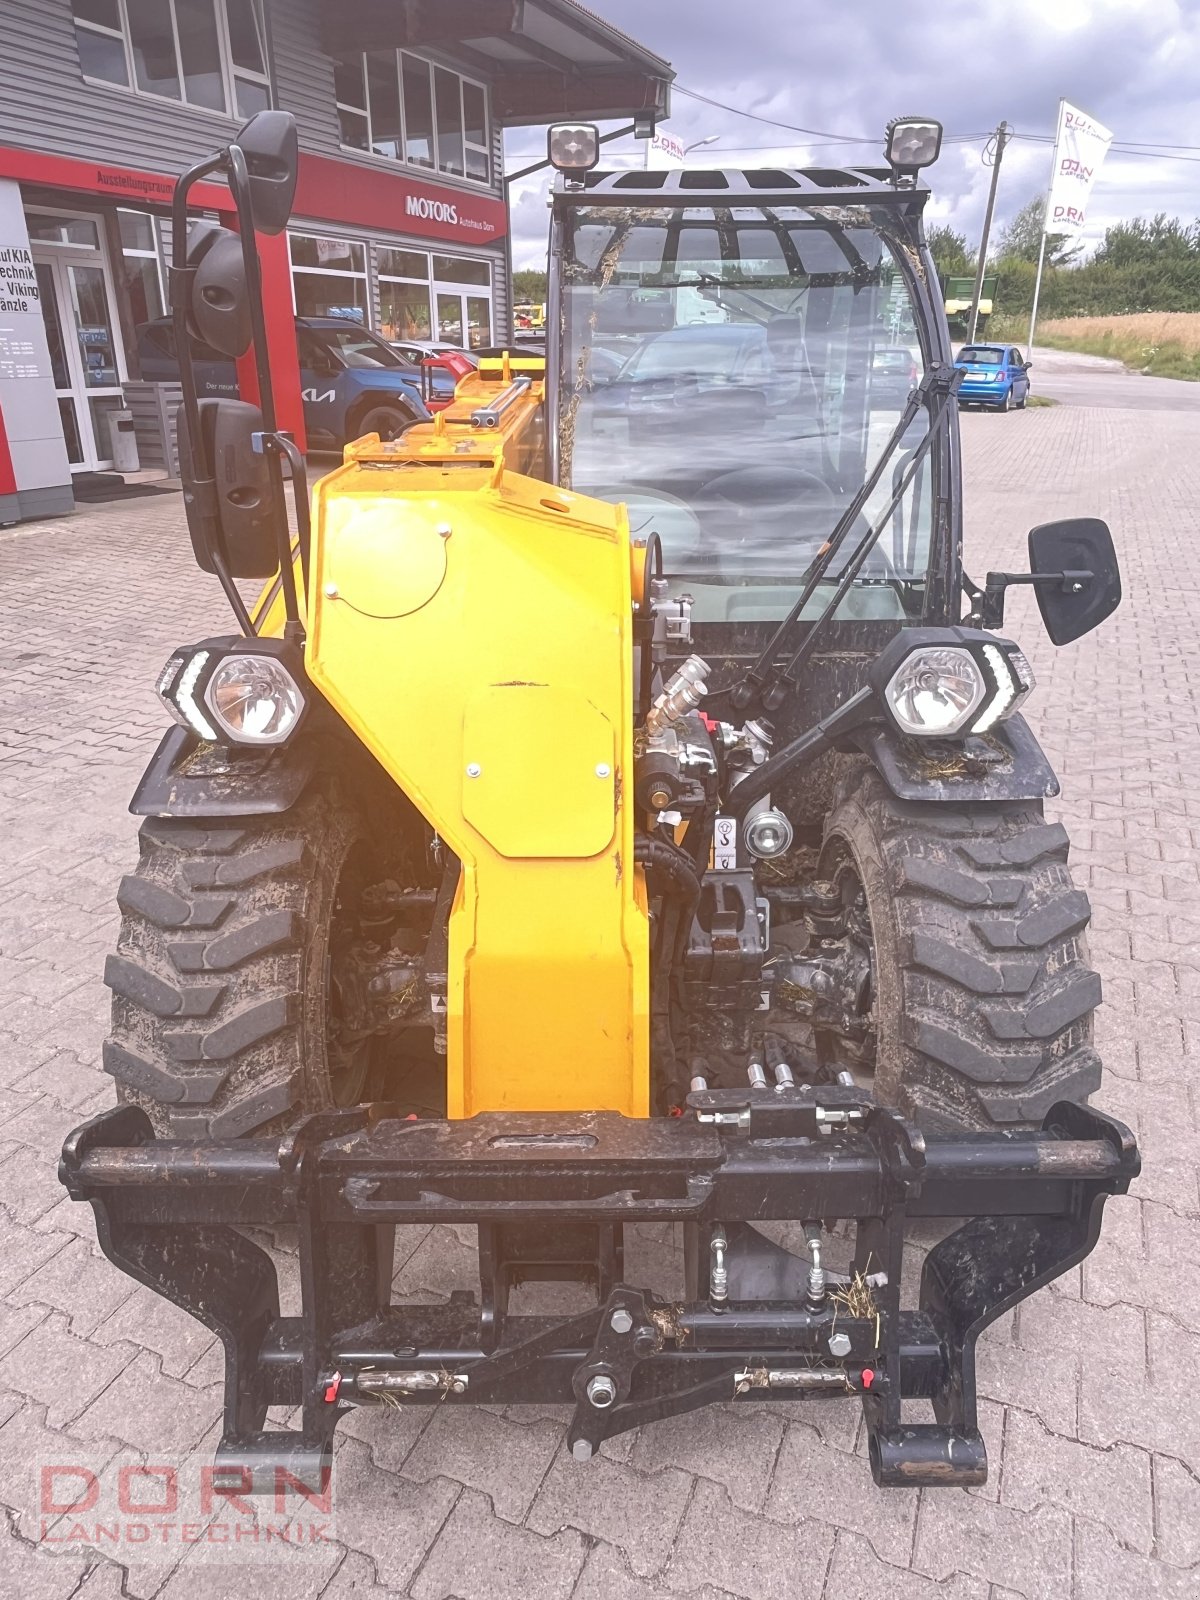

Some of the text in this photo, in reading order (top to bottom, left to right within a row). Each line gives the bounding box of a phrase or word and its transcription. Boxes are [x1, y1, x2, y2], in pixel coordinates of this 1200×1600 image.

[652, 133, 684, 157] DORN
[97, 170, 173, 194] Ausstellungsraum
[405, 195, 495, 232] MOTORS Autohaus Dorn
[0, 249, 31, 264] uf KIA
[0, 265, 35, 281] echnik
[7, 282, 39, 301] Viking
[206, 381, 217, 390] Der
